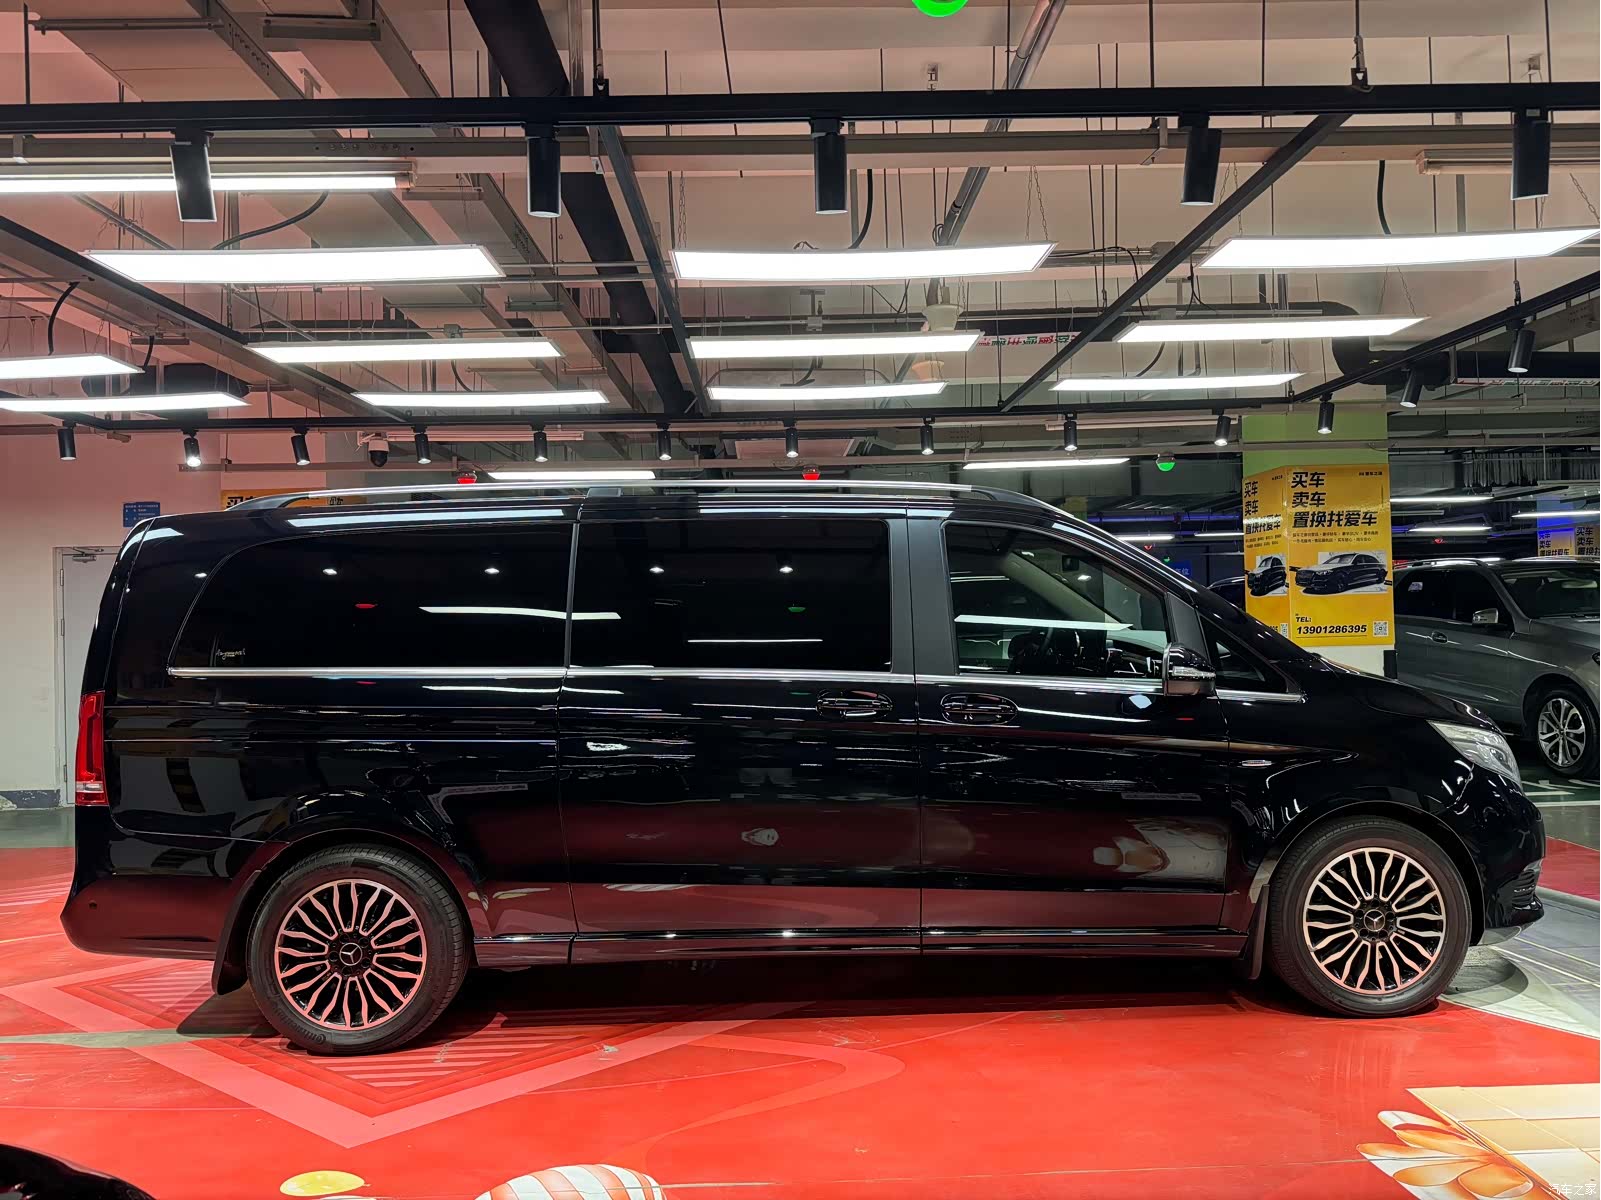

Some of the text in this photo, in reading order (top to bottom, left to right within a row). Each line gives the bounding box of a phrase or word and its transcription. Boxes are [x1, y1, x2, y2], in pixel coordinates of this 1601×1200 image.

[1291, 471, 1327, 488] 买车
[1244, 481, 1258, 498] 买车
[1244, 499, 1259, 516] 卖车
[1291, 491, 1327, 508] 卖车
[1292, 510, 1378, 528] 置换找爱车
[1297, 625, 1367, 635] 13901286395
